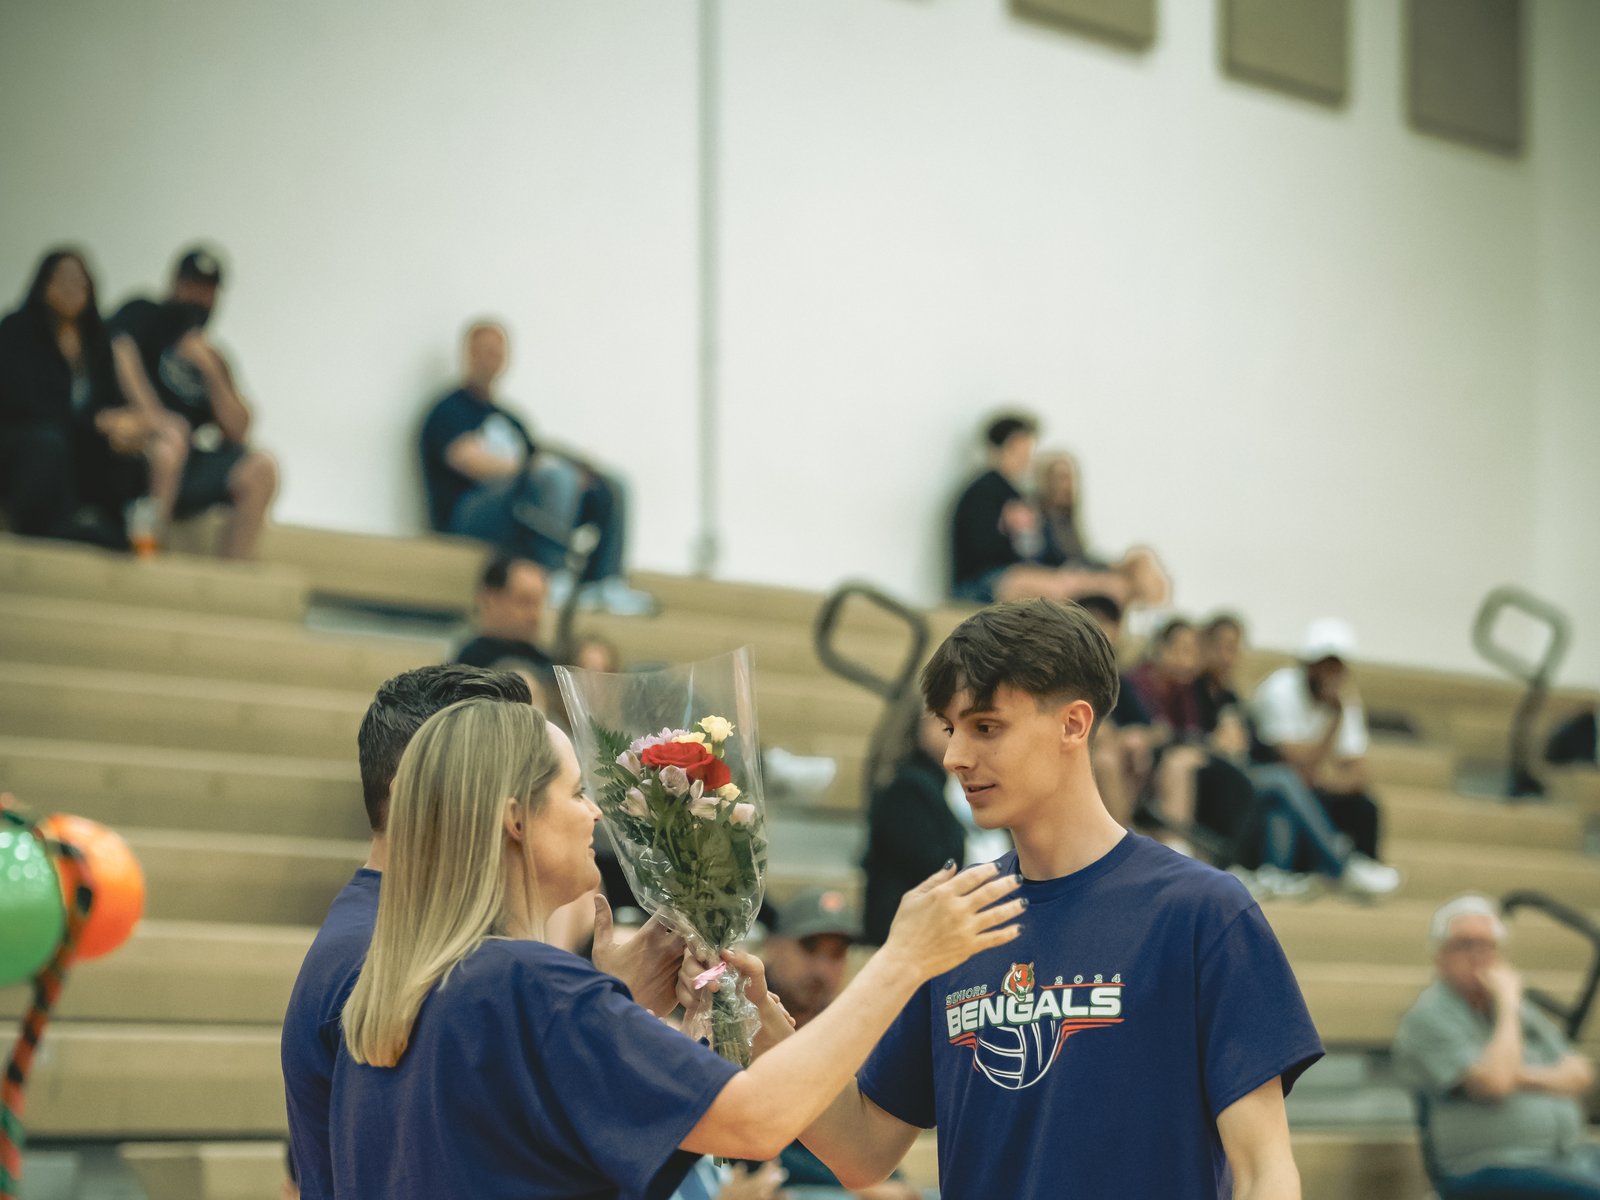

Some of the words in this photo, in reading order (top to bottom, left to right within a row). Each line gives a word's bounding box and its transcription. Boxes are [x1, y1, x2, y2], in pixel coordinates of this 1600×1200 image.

[945, 984, 988, 1006] SENIORS
[1054, 973, 1121, 985] 2024
[945, 987, 1122, 1038] BENGALS
